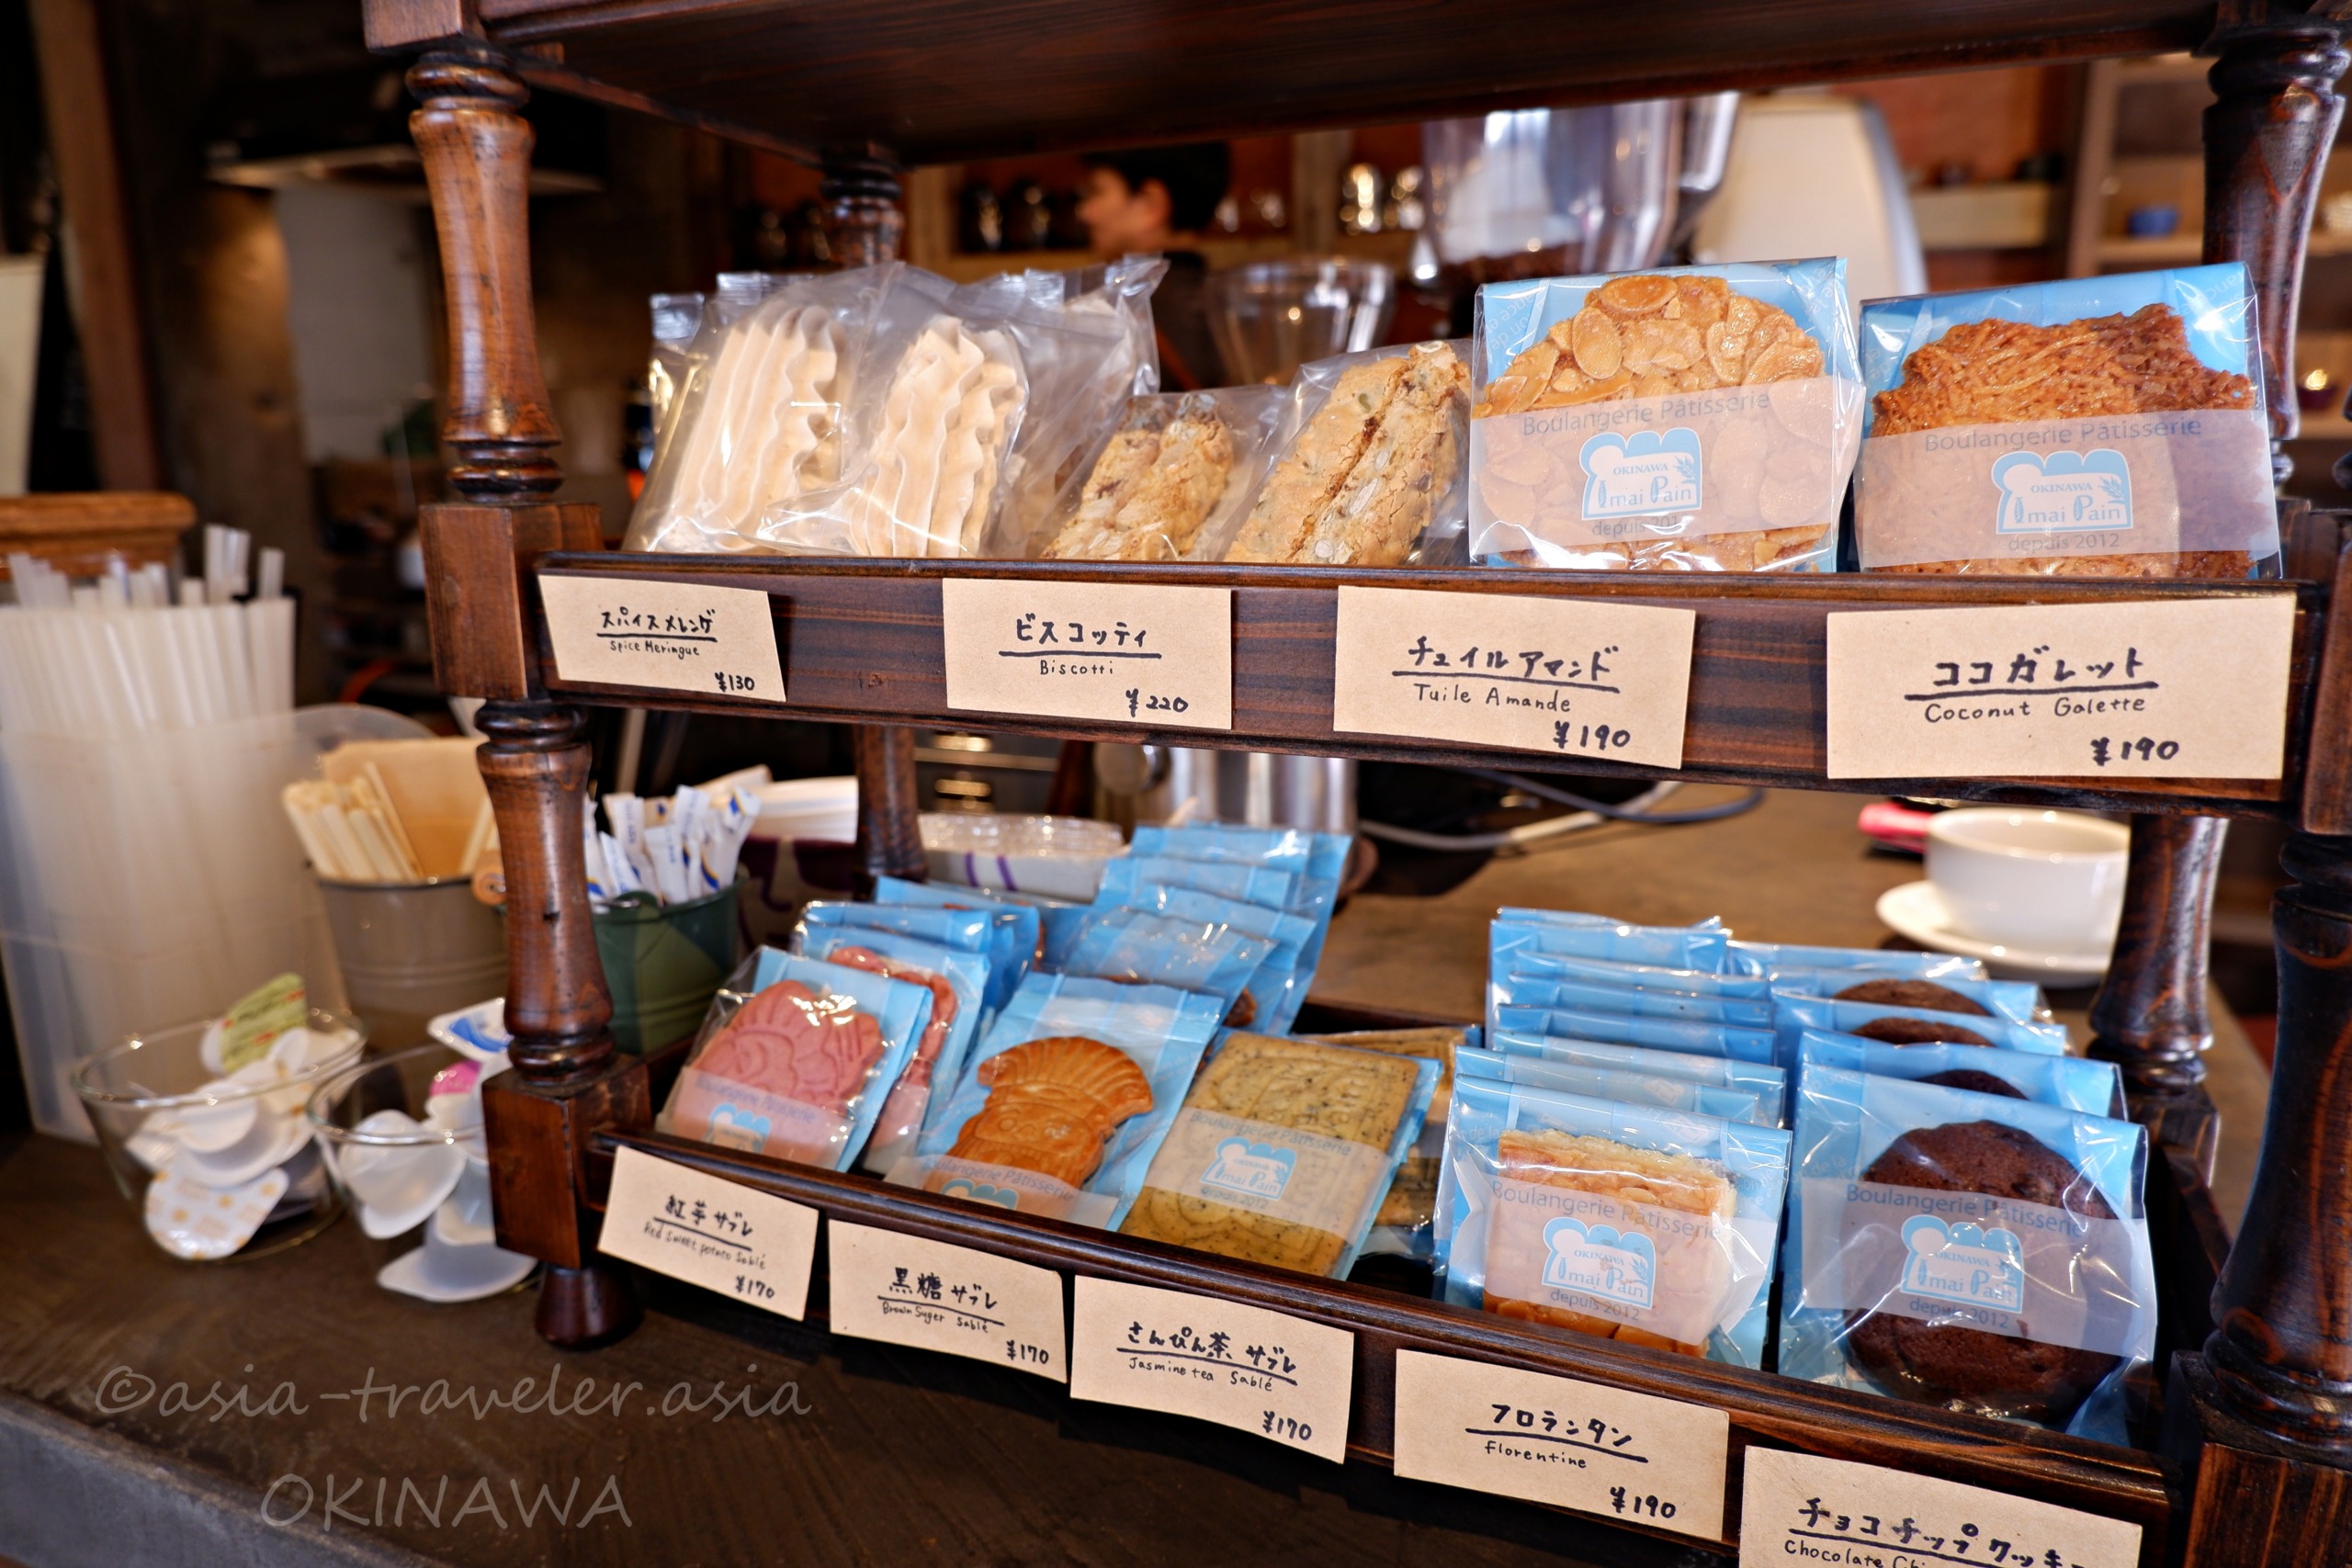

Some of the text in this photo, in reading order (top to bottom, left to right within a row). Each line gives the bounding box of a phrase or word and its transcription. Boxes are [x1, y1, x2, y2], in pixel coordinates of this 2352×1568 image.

[1523, 392, 1770, 436] Boulangerie Pâtisserie
[1925, 417, 2202, 452] Boulangerie Pâtisserie
[1612, 462, 1668, 476] OKINAWA
[1649, 475, 1692, 504] Pain
[2030, 482, 2093, 494] OKINAWA
[2073, 494, 2121, 522] Pain
[1591, 516, 1645, 537] depuis
[2008, 534, 2120, 552] depuis 2012
[1016, 613, 1147, 648] ビスコッティ
[610, 640, 700, 660] Spice Meringue
[1040, 660, 1114, 675] Biscotti
[1933, 645, 2143, 685] ココガレット
[715, 671, 755, 692] ¥130
[1413, 682, 1571, 712] Tuile Amande
[1925, 697, 2145, 723] Coconut Galette
[1553, 720, 1631, 750] ¥190
[2090, 737, 2179, 766] ¥190
[1491, 1180, 1721, 1240] Boulangerie Pâtisserie
[1847, 1183, 2084, 1238] Boulangerie Pâtisserie
[644, 1221, 664, 1239] Red
[667, 1230, 698, 1250] Sweet
[700, 1243, 732, 1260] potato
[1574, 1249, 1625, 1267] OKINAWA
[1933, 1250, 1991, 1268] OKINAWA
[736, 1275, 775, 1299] ¥170
[1605, 1266, 1644, 1299] Pain
[882, 1302, 912, 1314] Brown
[1551, 1289, 1640, 1322] depuis 2012
[1969, 1307, 2009, 1330] 2012
[1006, 1339, 1049, 1364] ¥170
[1129, 1357, 1272, 1392] Jasmine tea Sablé
[1262, 1410, 1312, 1440] ¥170
[1491, 1404, 1633, 1447] フロランタン
[1610, 1486, 1677, 1518] ¥190
[1784, 1540, 1883, 1568] Chocolate
